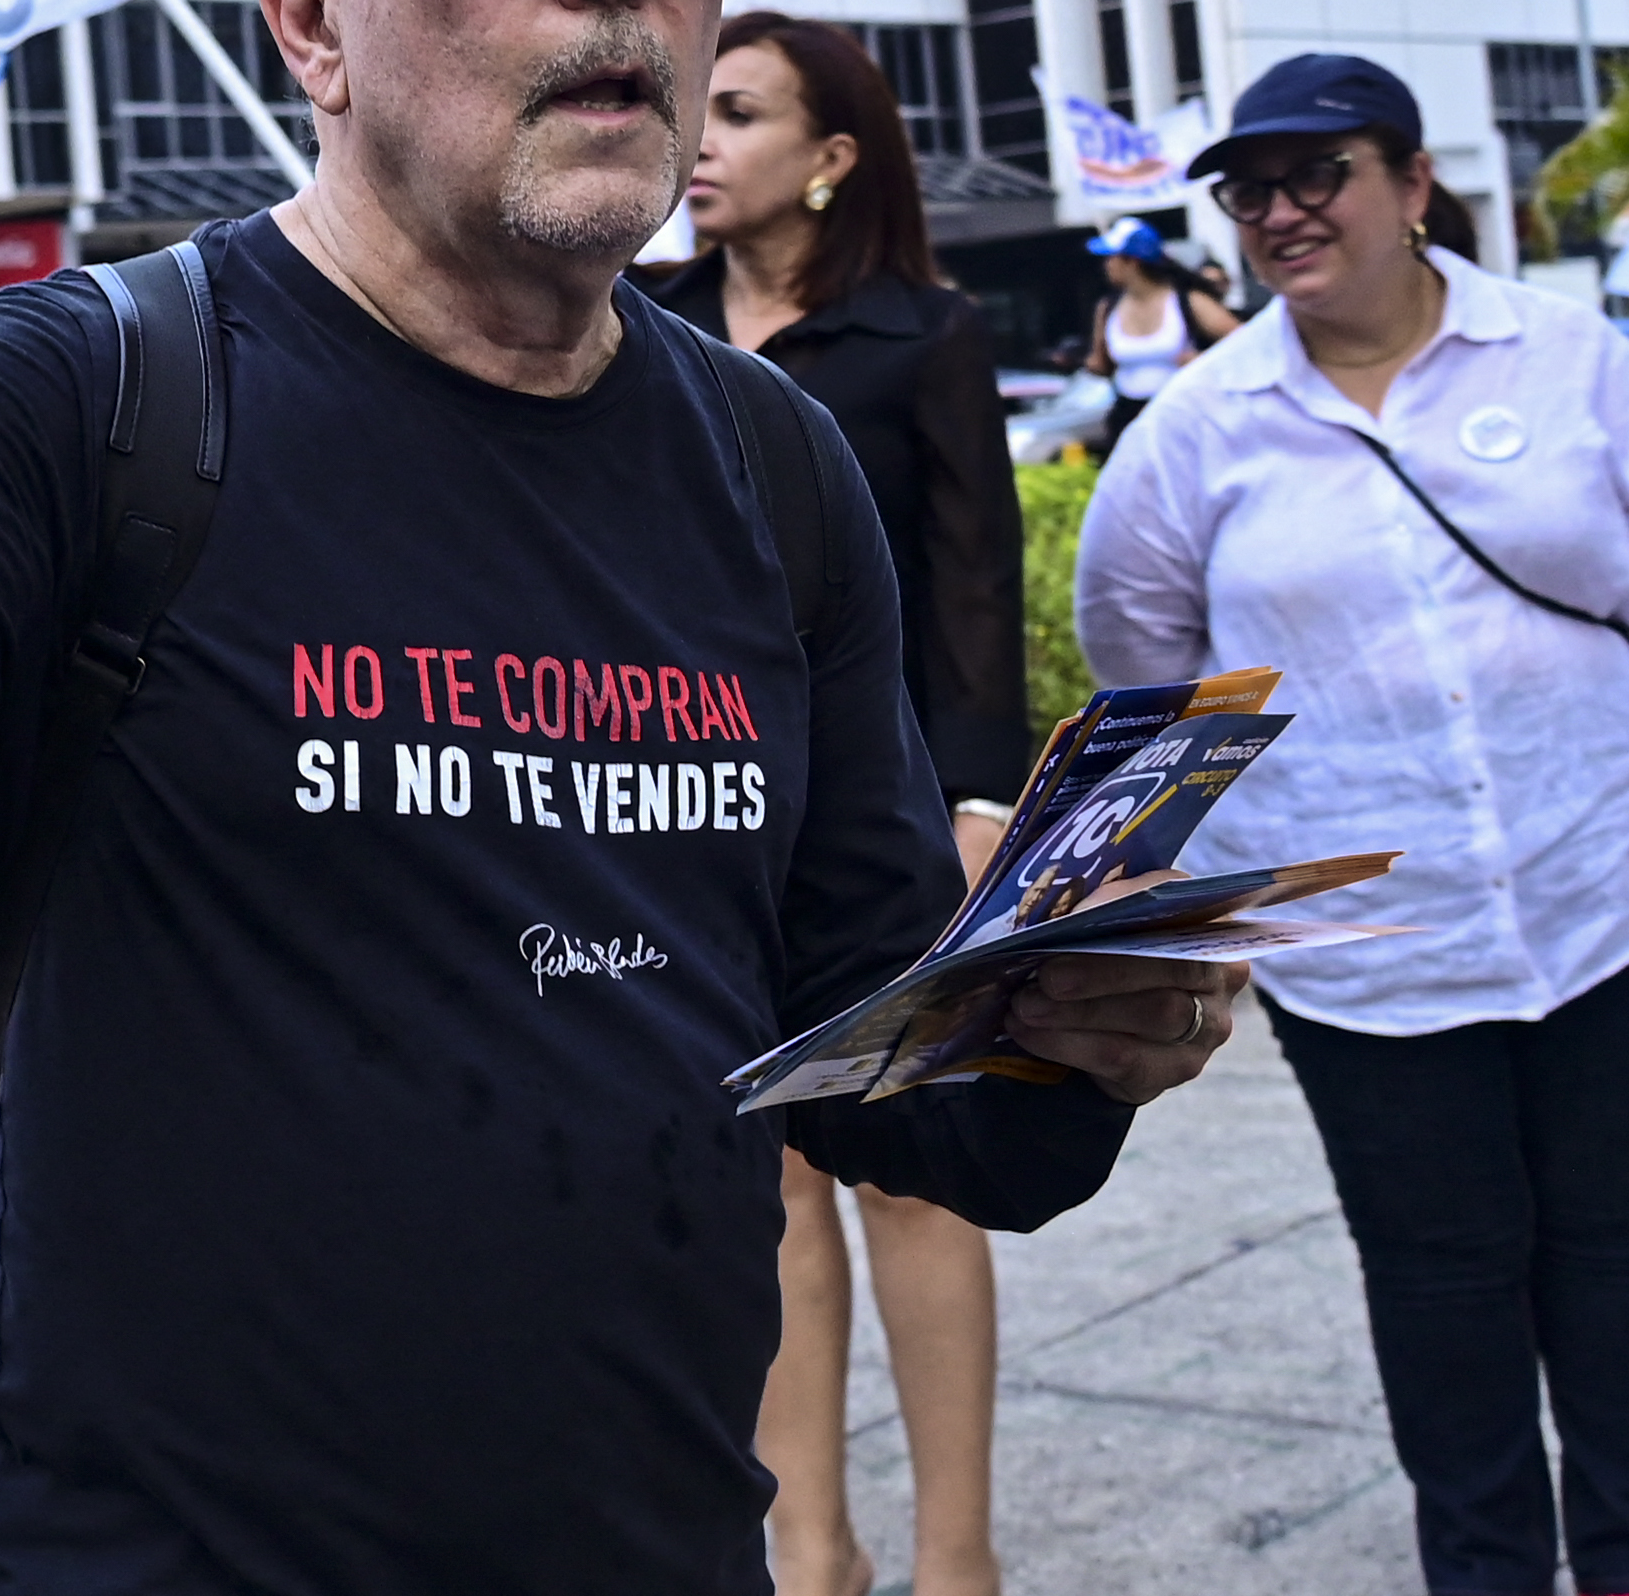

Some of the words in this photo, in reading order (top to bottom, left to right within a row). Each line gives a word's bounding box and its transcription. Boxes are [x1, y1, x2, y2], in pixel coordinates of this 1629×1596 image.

[292, 642, 384, 721] NO
[404, 645, 482, 729] TE
[492, 652, 761, 744] COMPRAN
[295, 738, 361, 814] SI
[394, 742, 472, 817] NO
[491, 749, 563, 830] TE
[570, 760, 767, 835] VENDES
[1120, 737, 1194, 775] VOTA
[1201, 736, 1262, 763] Vamos
